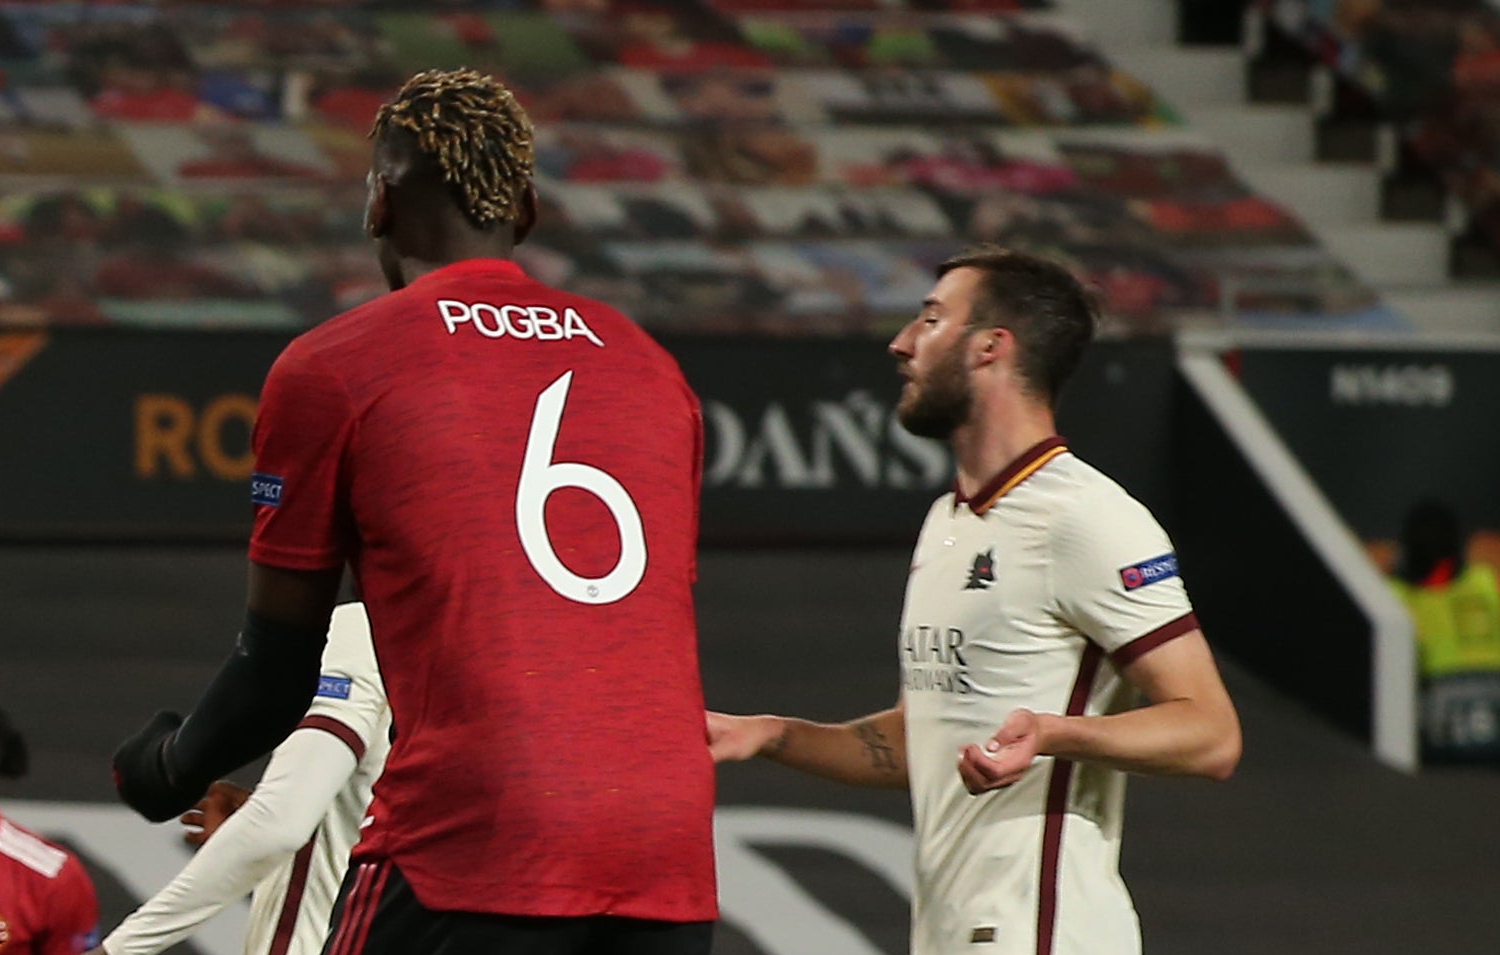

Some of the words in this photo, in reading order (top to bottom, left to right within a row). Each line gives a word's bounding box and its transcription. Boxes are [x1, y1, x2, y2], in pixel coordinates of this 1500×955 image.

[436, 299, 605, 347] POGBA
[133, 393, 258, 481] RO
[251, 480, 282, 499] SPECT
[514, 369, 649, 605] 6
[902, 624, 967, 666] ATAR
